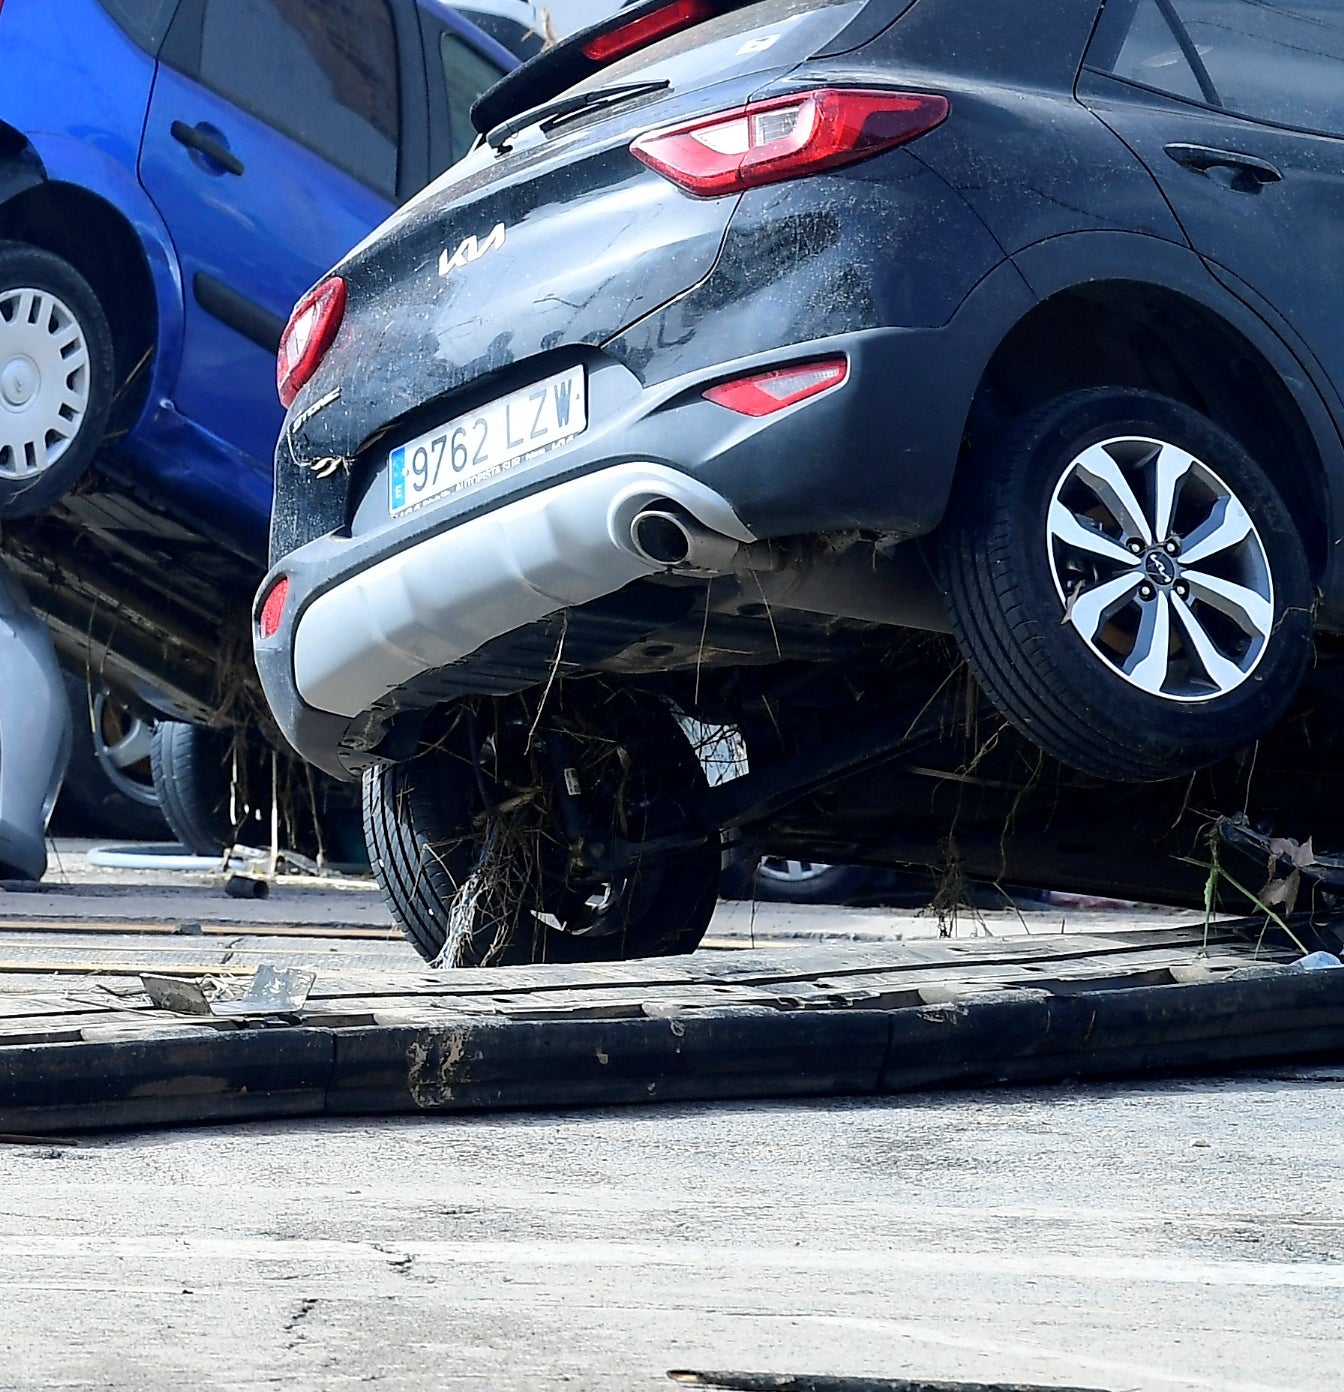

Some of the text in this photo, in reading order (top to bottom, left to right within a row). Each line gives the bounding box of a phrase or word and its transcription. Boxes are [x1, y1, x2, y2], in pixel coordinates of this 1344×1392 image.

[438, 222, 506, 276] KIA
[411, 378, 573, 493] 9762 LZW
